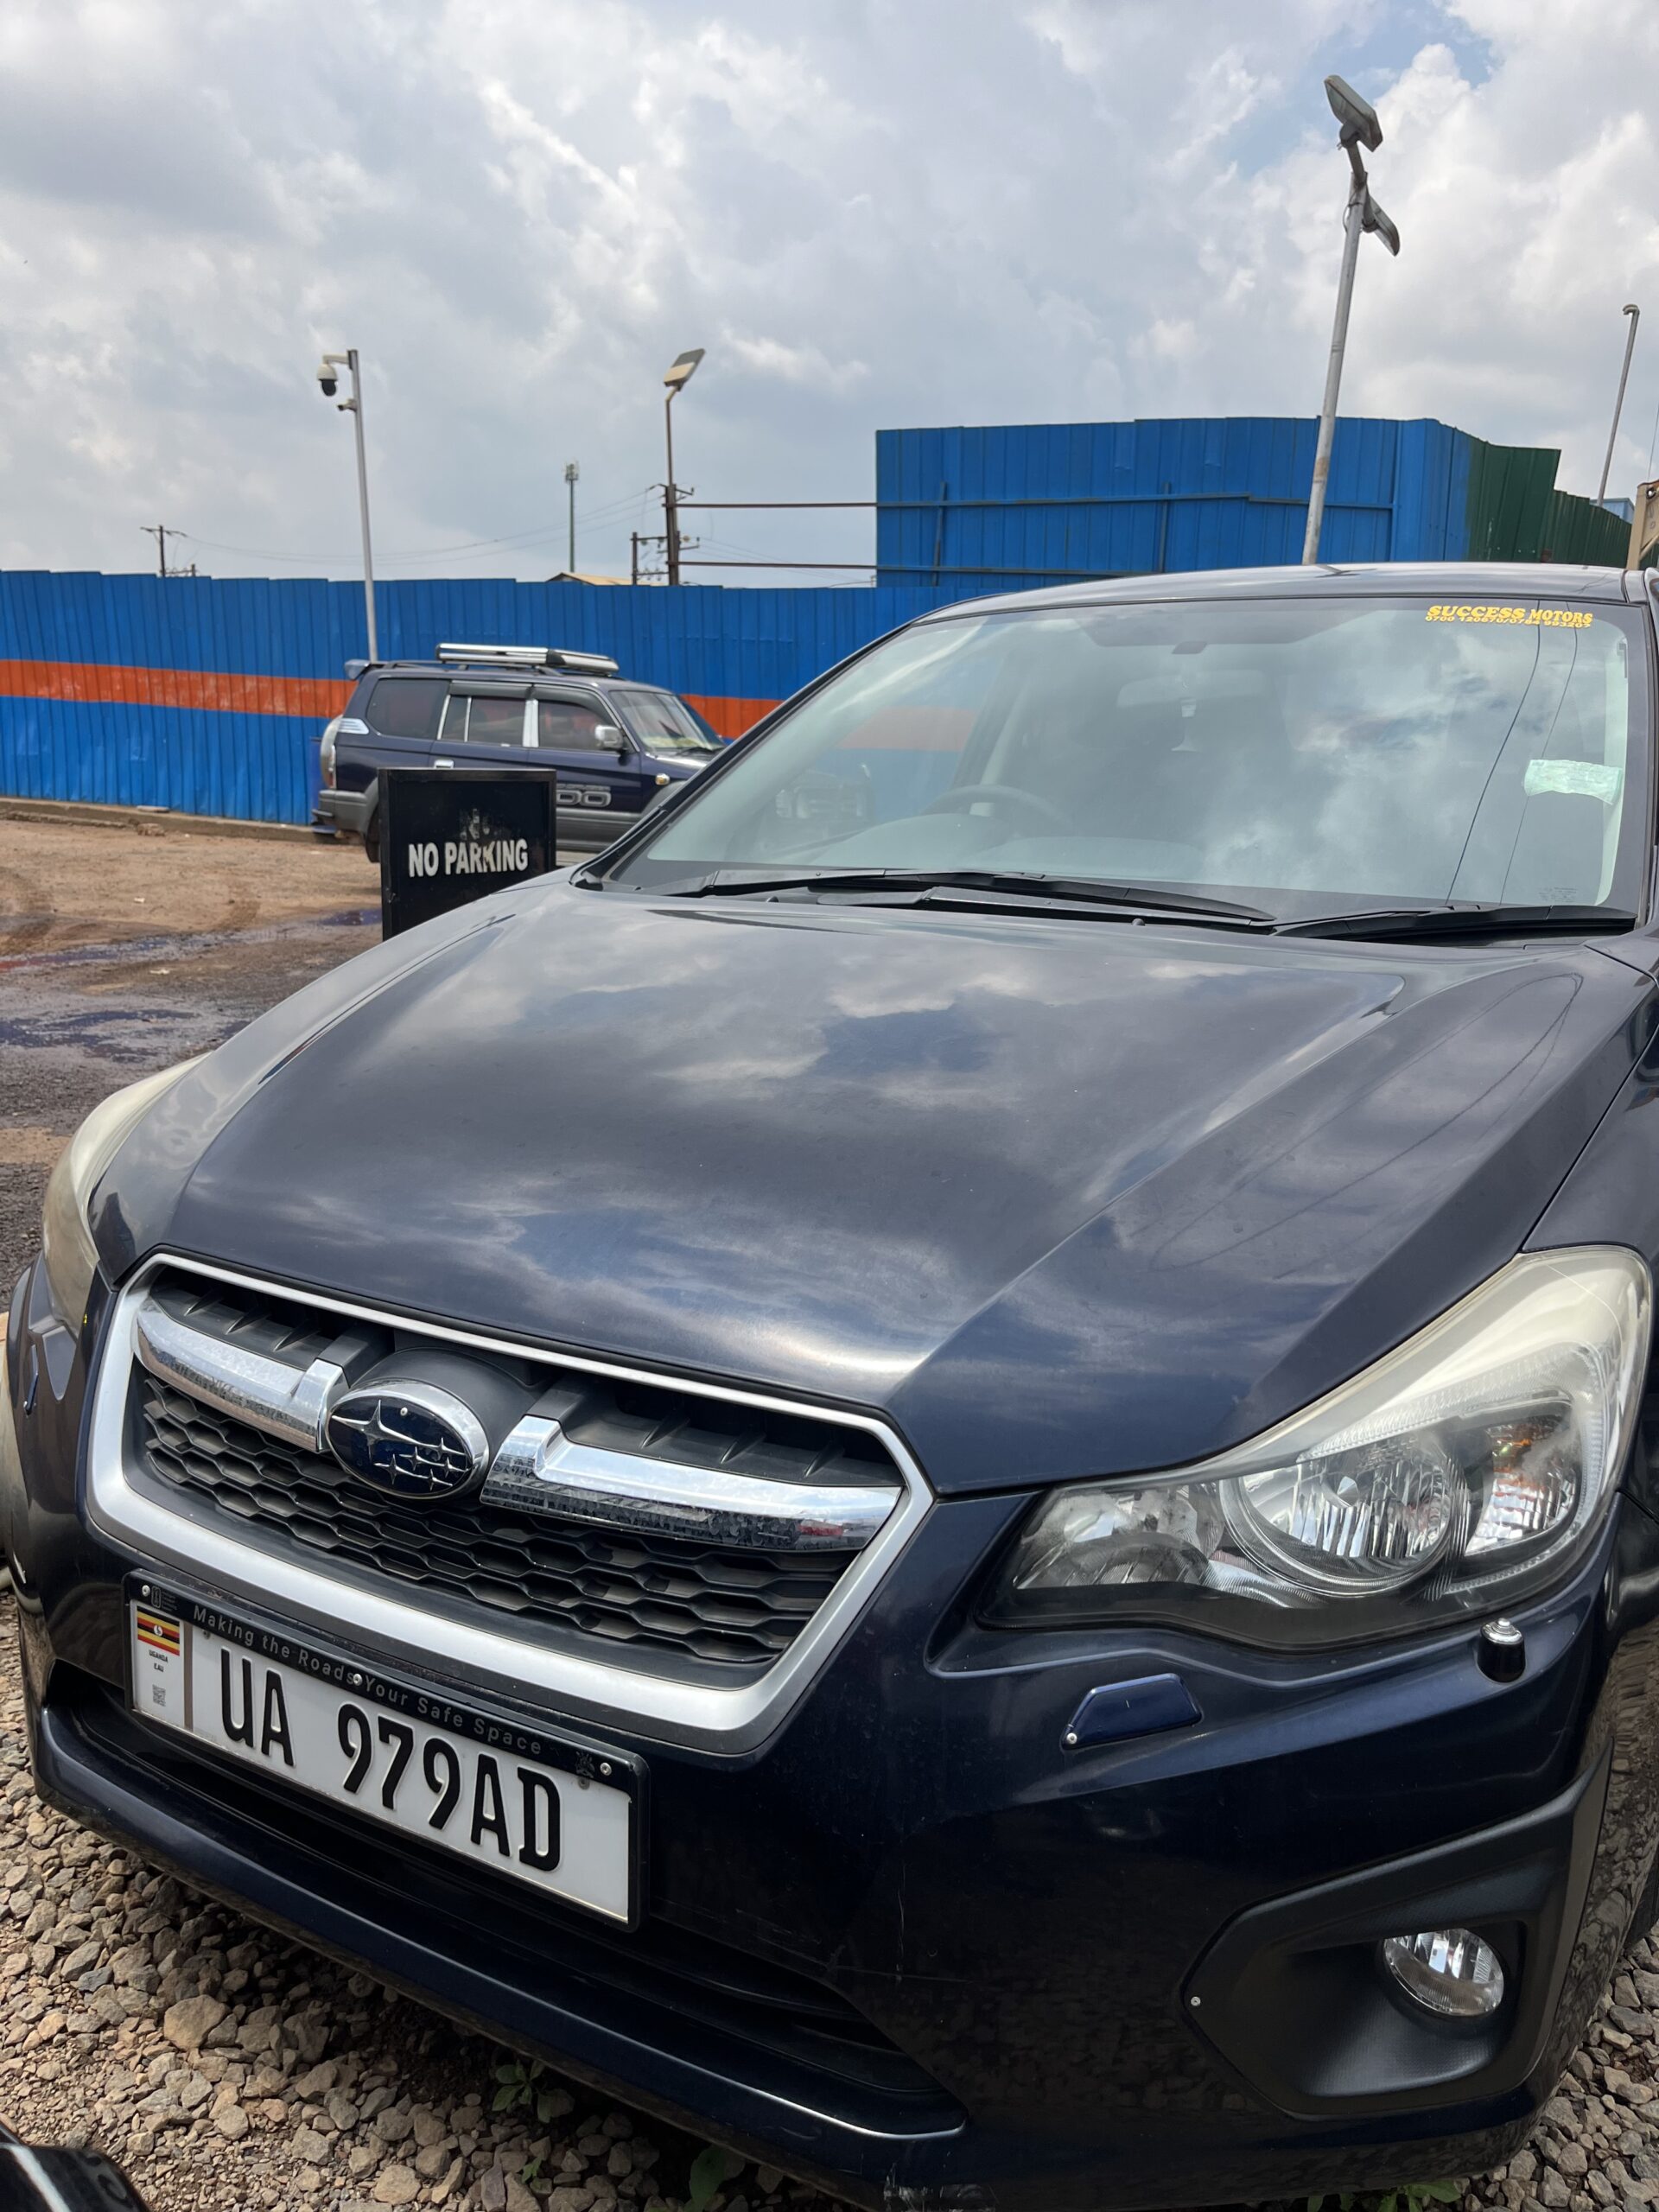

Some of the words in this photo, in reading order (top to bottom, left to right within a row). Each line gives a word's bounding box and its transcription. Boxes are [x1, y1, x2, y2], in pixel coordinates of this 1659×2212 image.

[1427, 606, 1526, 620] SUCCESS
[1528, 609, 1592, 624] MOTORS
[409, 842, 439, 877] NO
[444, 838, 528, 875] PARKING
[149, 1649, 168, 1663] UGANDA
[153, 1662, 164, 1673] EAU
[193, 1605, 254, 1646] Making
[262, 1635, 290, 1658] the
[297, 1649, 355, 1685] Roads
[365, 1675, 408, 1706] Your
[417, 1697, 463, 1727] Safe
[474, 1718, 541, 1755] Space
[220, 1647, 296, 1767] UA
[337, 1704, 562, 1872] 979AD
